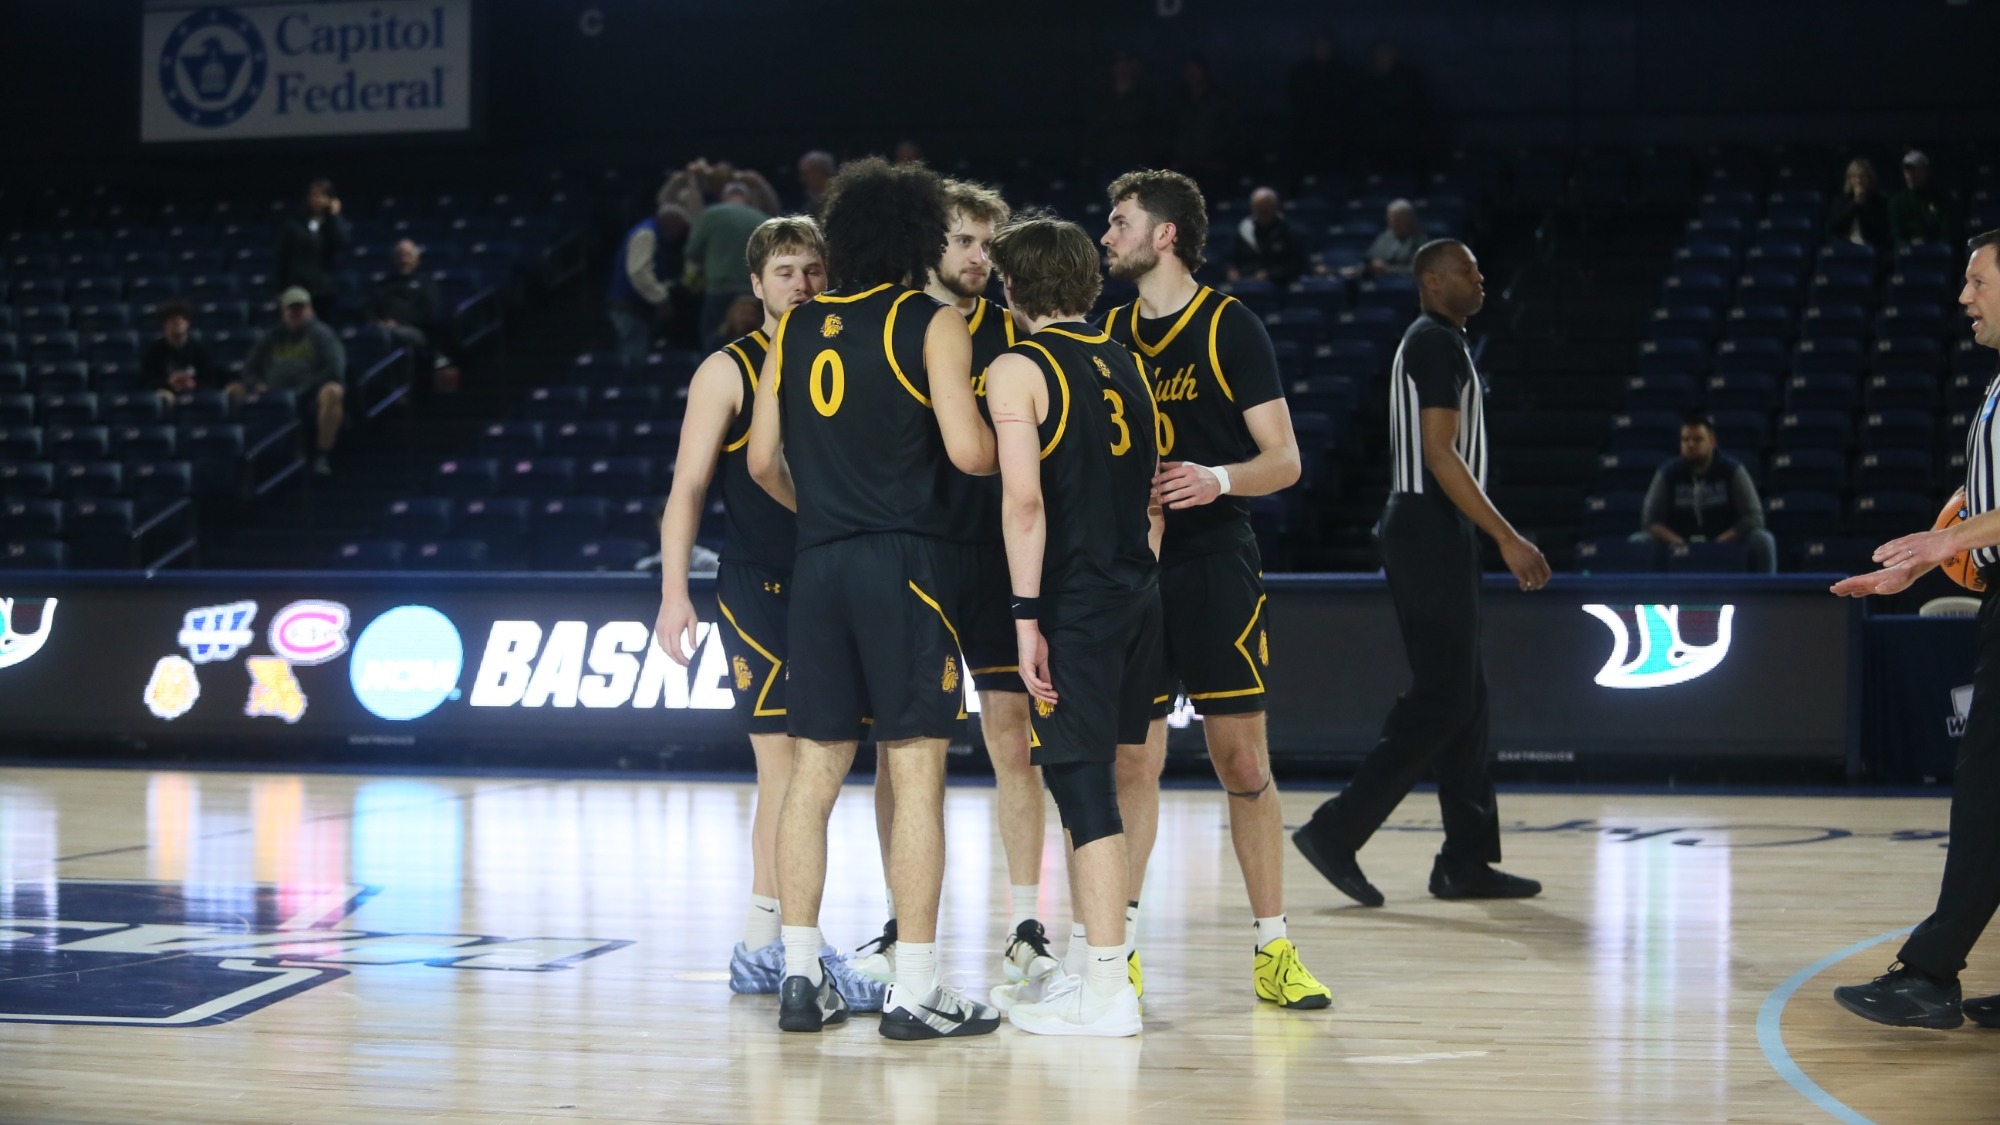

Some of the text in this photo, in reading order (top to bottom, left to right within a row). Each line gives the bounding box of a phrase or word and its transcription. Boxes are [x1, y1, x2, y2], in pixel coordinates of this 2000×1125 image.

[275, 6, 445, 63] Capitol
[579, 9, 605, 37] C
[275, 66, 445, 115] Federal
[809, 348, 845, 417] 0
[1154, 363, 1198, 402] uth
[1102, 388, 1131, 456] 3
